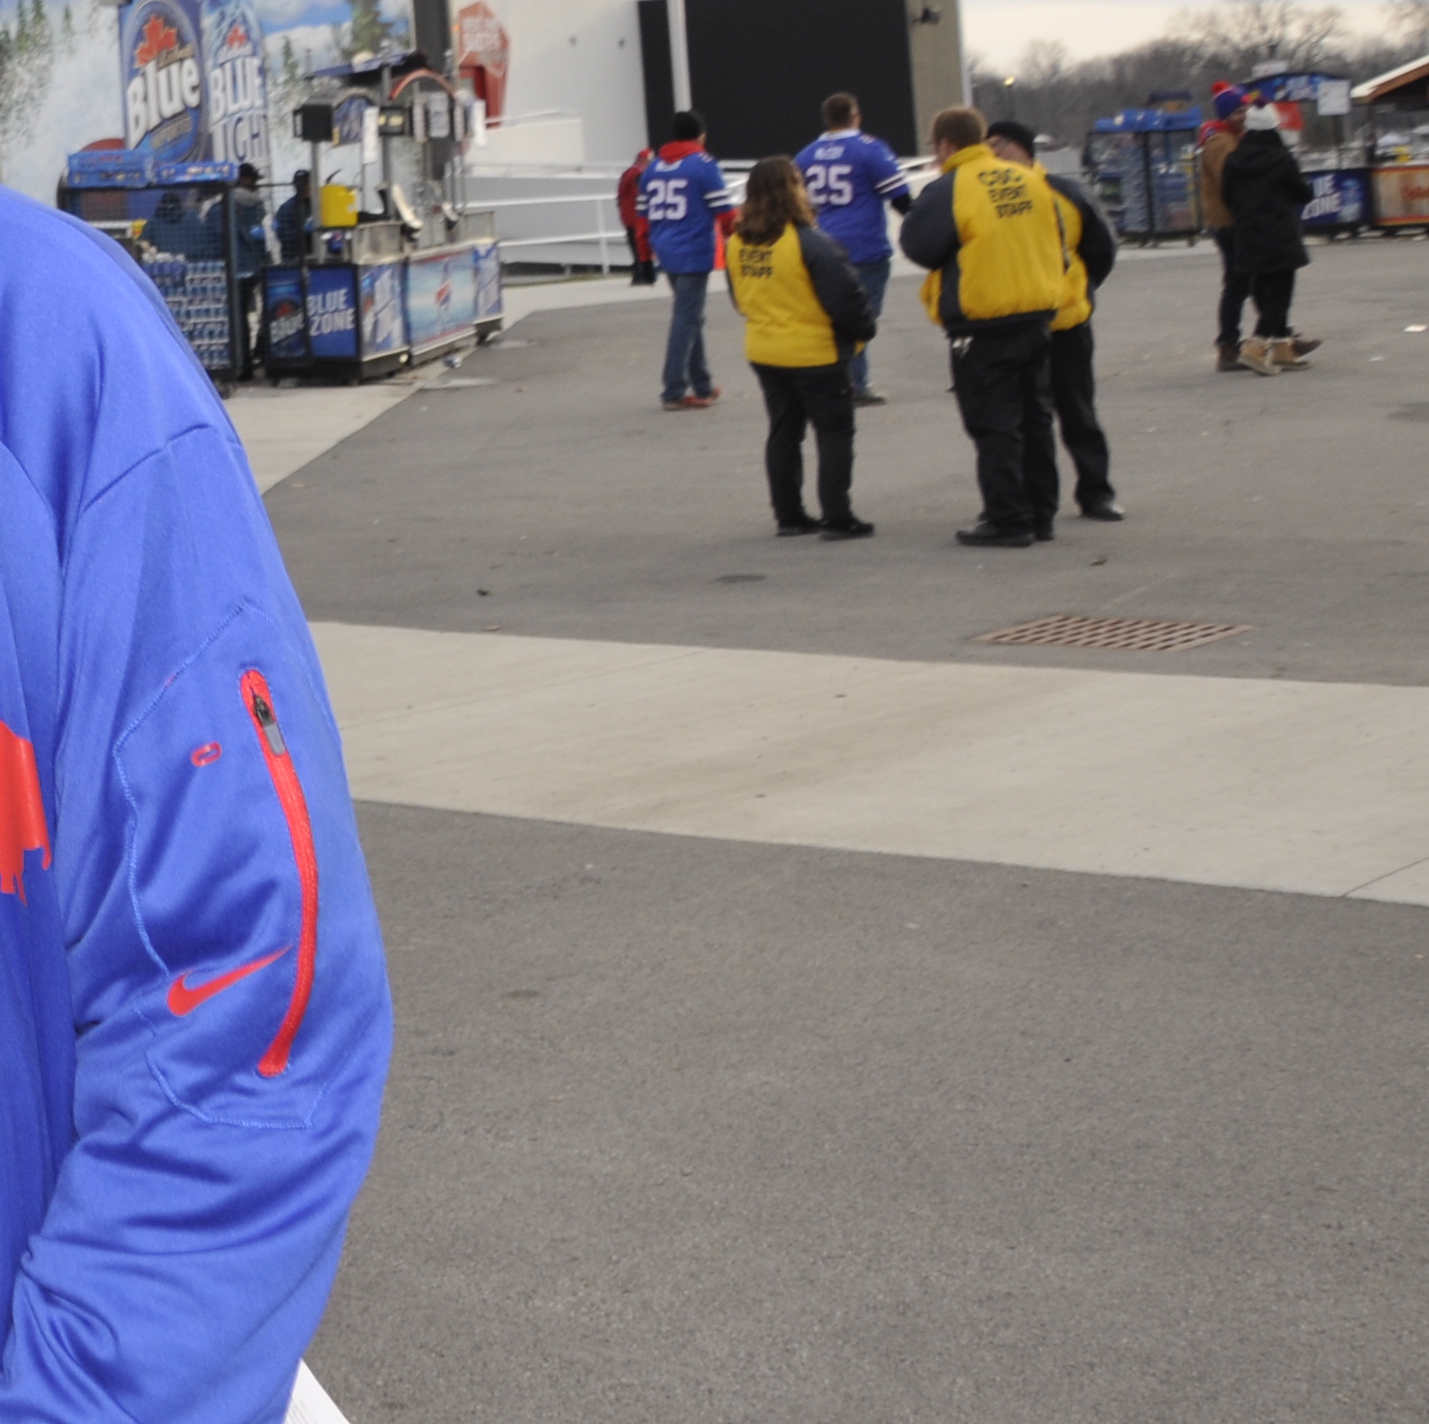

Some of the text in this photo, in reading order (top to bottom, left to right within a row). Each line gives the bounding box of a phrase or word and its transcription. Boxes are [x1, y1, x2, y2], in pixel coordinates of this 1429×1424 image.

[126, 57, 202, 151] Blue
[208, 57, 267, 127] BLUE
[646, 178, 688, 221] 25
[805, 164, 853, 206] 25
[307, 287, 349, 317] BLUE
[310, 308, 357, 337] ZONE
